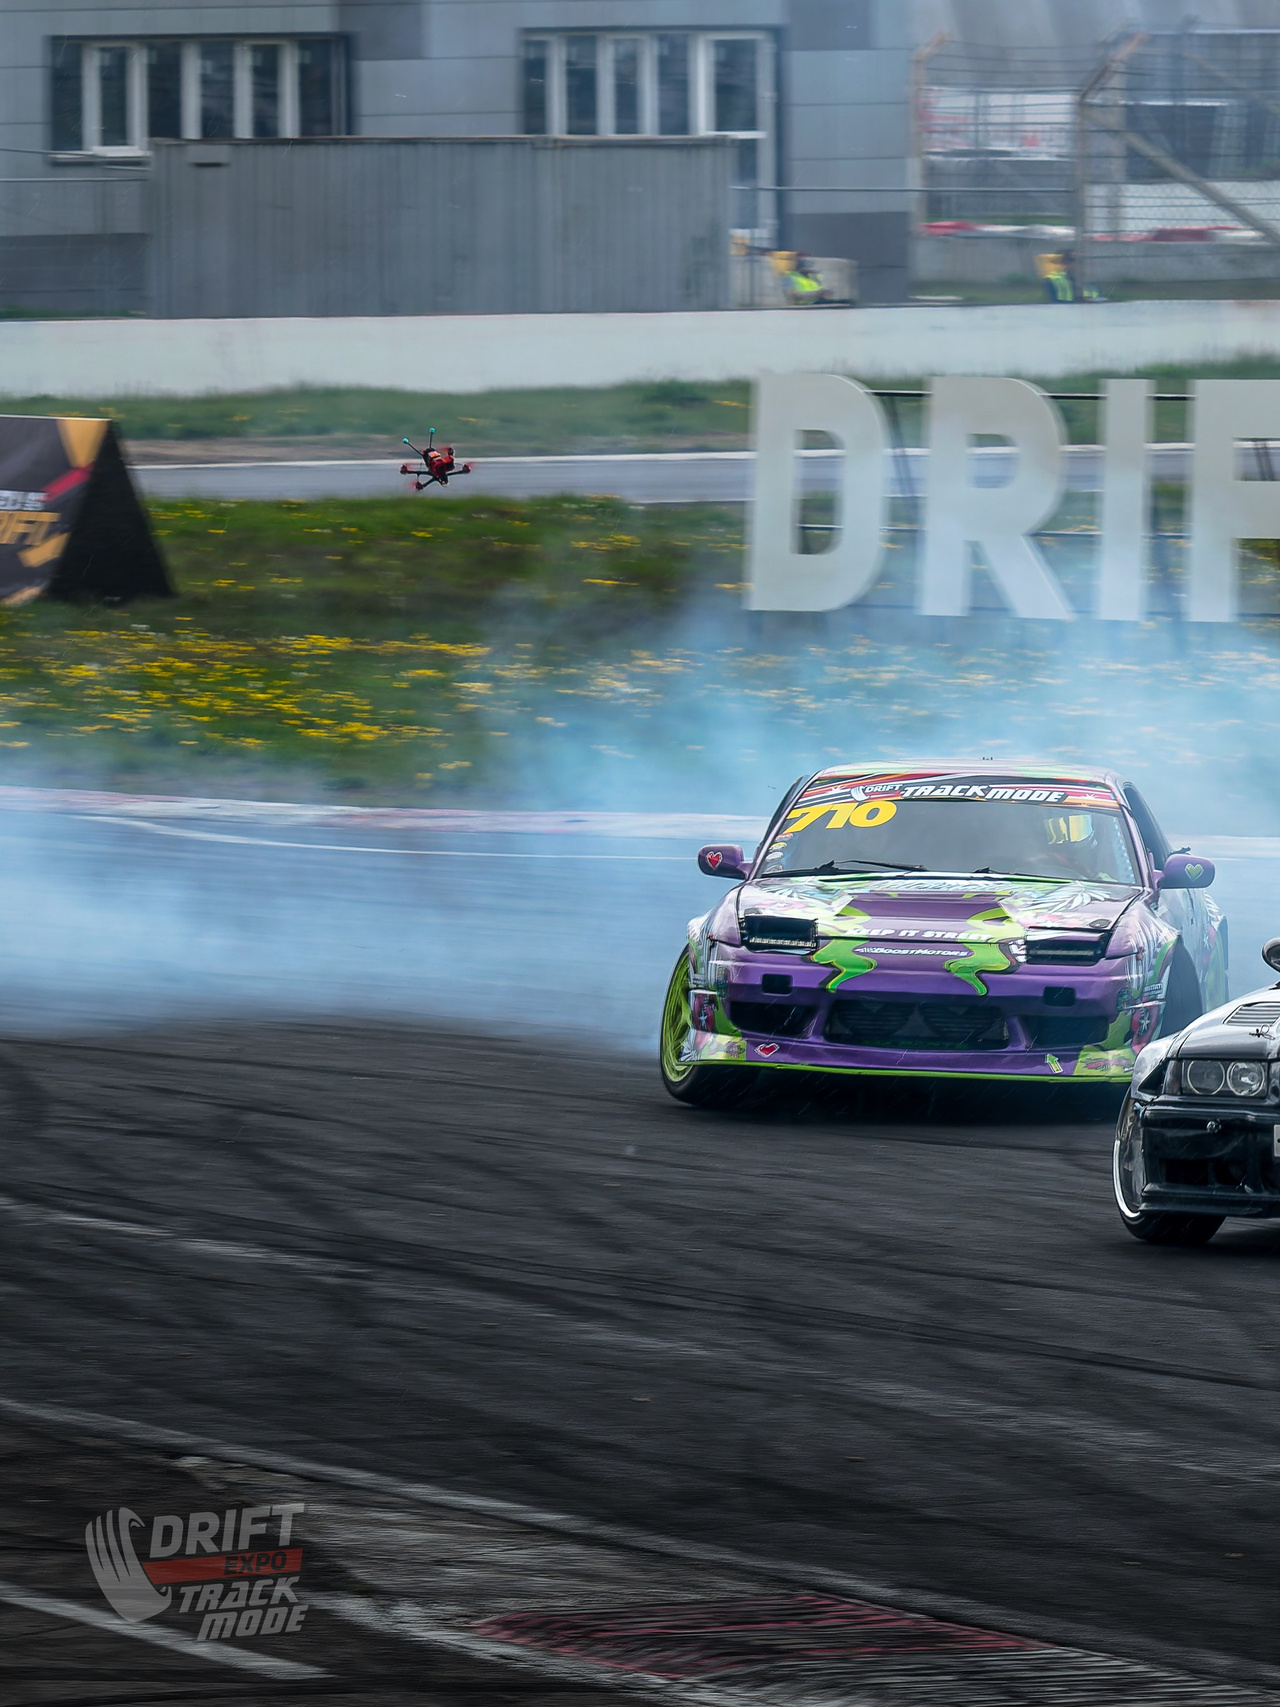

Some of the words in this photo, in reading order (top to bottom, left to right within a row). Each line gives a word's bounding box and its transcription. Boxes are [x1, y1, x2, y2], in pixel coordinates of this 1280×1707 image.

[865, 784, 903, 793] DRIFT
[783, 800, 897, 834] 710
[844, 928, 895, 936] KEEP
[898, 929, 920, 937] IT
[922, 930, 992, 941] STREET
